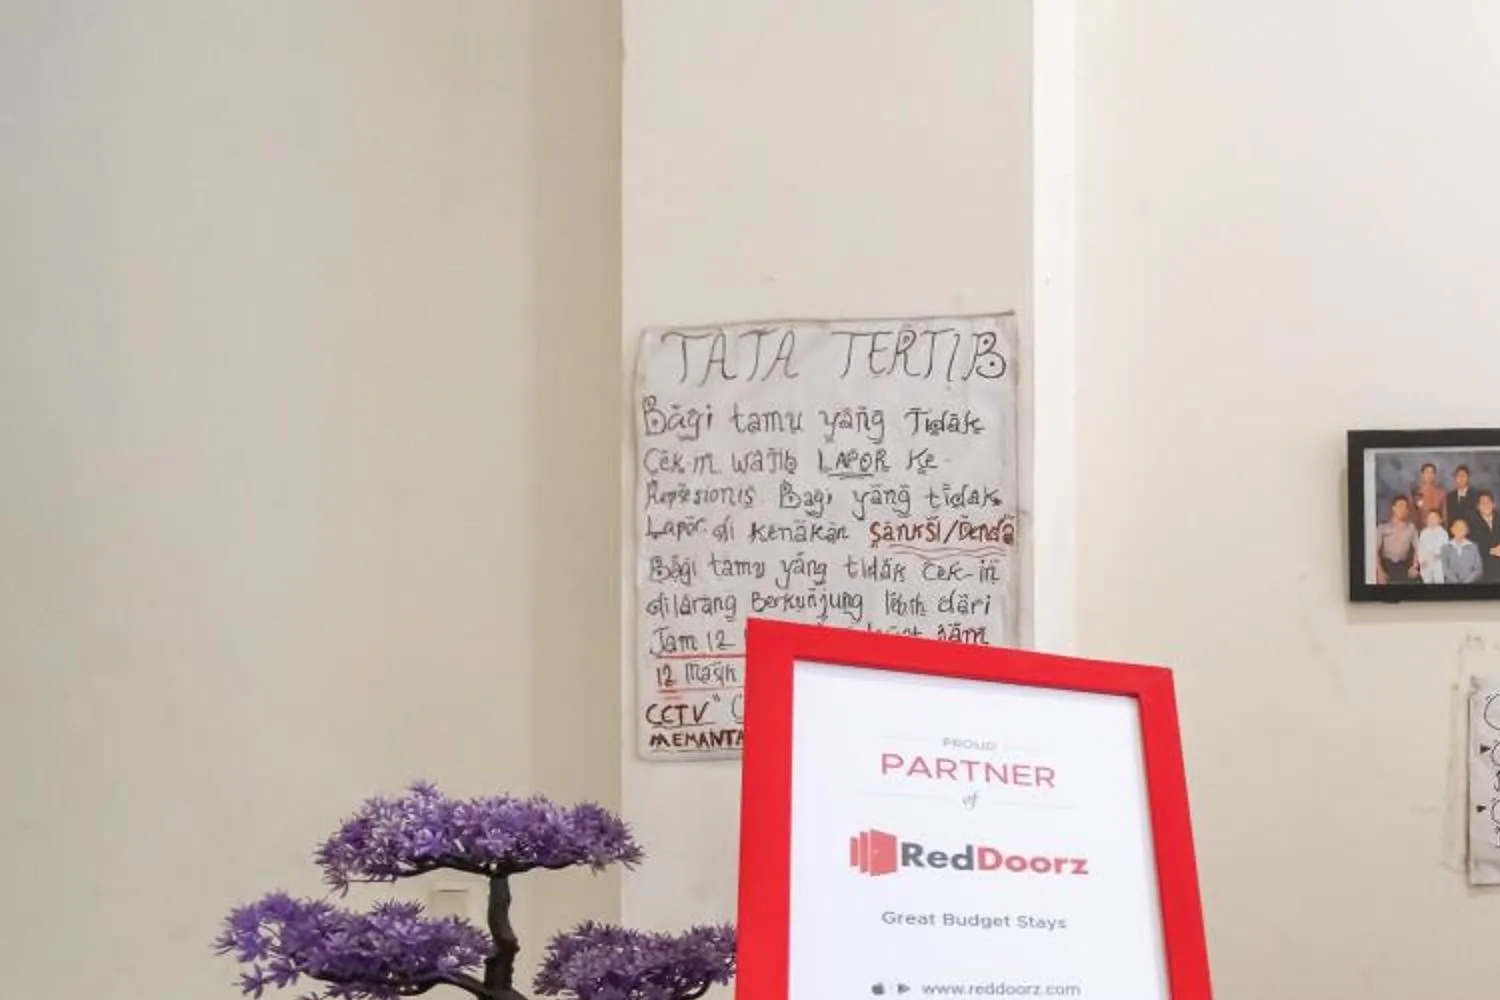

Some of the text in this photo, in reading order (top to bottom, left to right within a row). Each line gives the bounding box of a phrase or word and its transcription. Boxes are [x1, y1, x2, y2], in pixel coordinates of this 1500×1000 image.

[660, 327, 1007, 387] TATA TERTIB
[643, 396, 713, 441] Bagi
[730, 404, 803, 434] tamu
[819, 406, 886, 443] yang
[818, 448, 891, 476] LAPOR
[851, 484, 911, 520] yang
[707, 553, 765, 579] tamu
[776, 553, 827, 588] yang
[937, 590, 992, 616] dari
[881, 752, 1056, 788] PARTNER
[900, 842, 1090, 875] RedDoorz
[881, 911, 1067, 931] Great Budget Stays
[921, 981, 1081, 996] www.reddoorz.com
